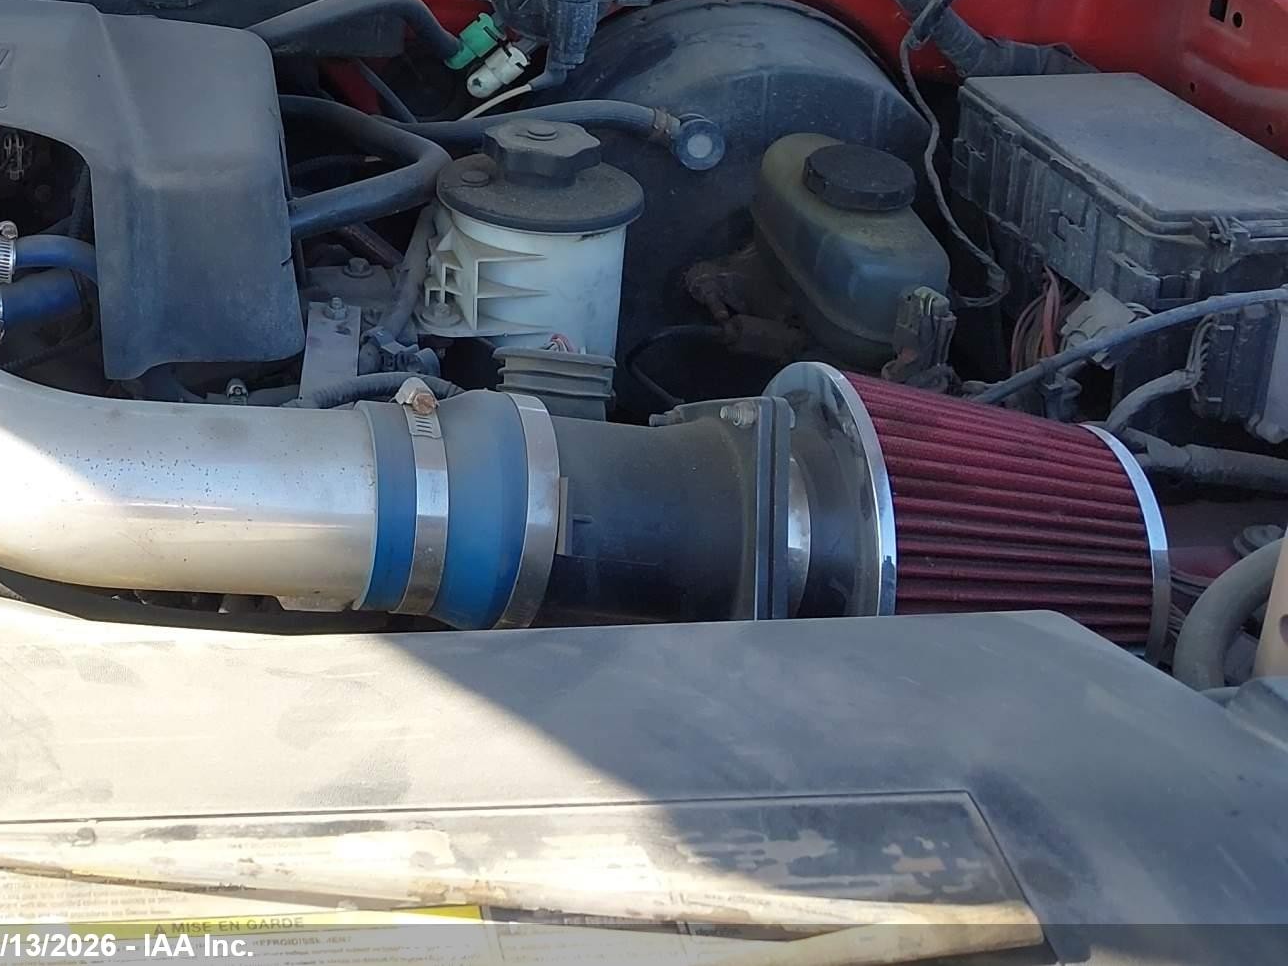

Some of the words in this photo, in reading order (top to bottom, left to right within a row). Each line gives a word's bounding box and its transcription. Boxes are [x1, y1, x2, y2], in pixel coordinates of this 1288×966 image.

[171, 921, 212, 934] MISE
[218, 920, 241, 932] EN
[246, 917, 305, 930] GARDE
